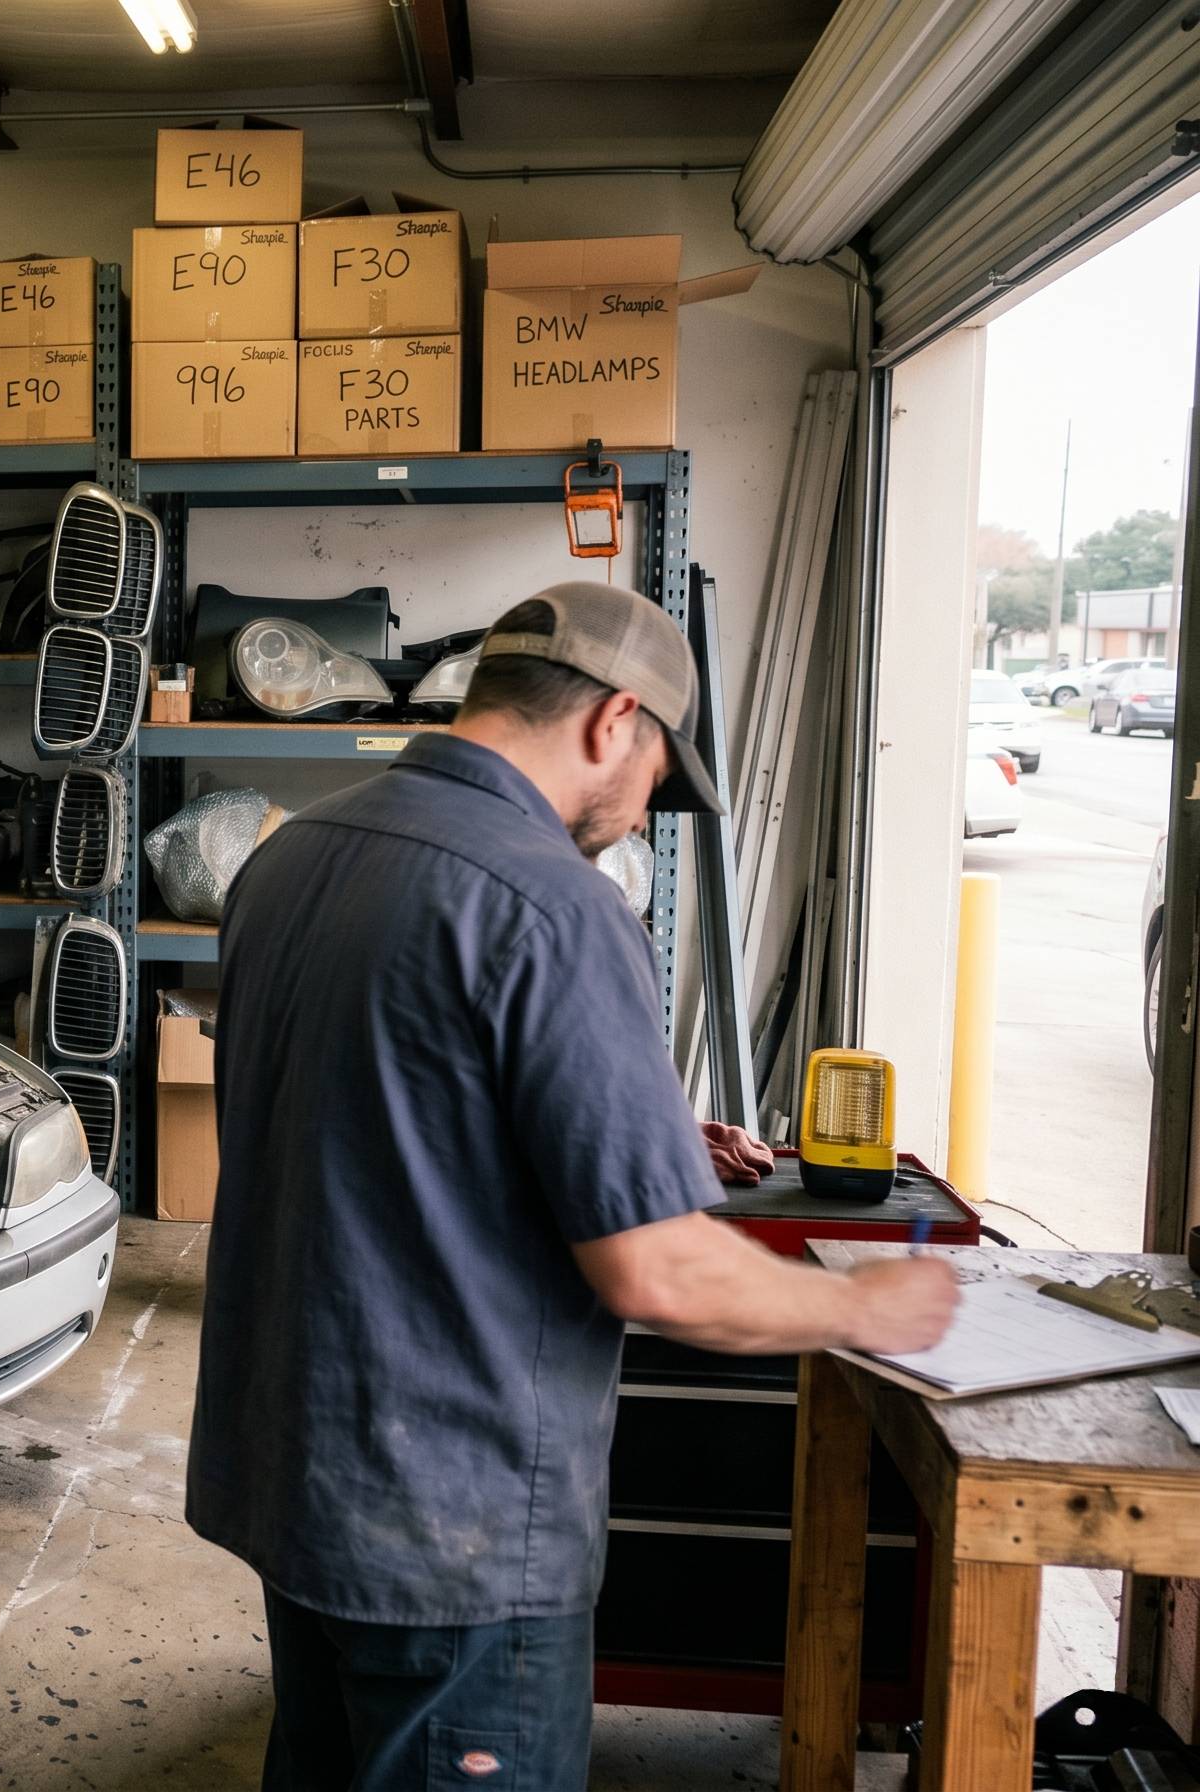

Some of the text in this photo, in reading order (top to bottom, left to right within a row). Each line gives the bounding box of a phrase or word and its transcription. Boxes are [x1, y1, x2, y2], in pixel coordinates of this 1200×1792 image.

[187, 153, 261, 188] E46
[173, 252, 246, 291] E90
[334, 247, 410, 287] F30
[1, 285, 55, 312] E46
[516, 313, 588, 344] BMW
[176, 365, 246, 405] 996
[340, 369, 409, 402] F30
[514, 357, 661, 388] HEADLAMPS
[7, 378, 61, 408] E90
[345, 406, 420, 432] PARTS
